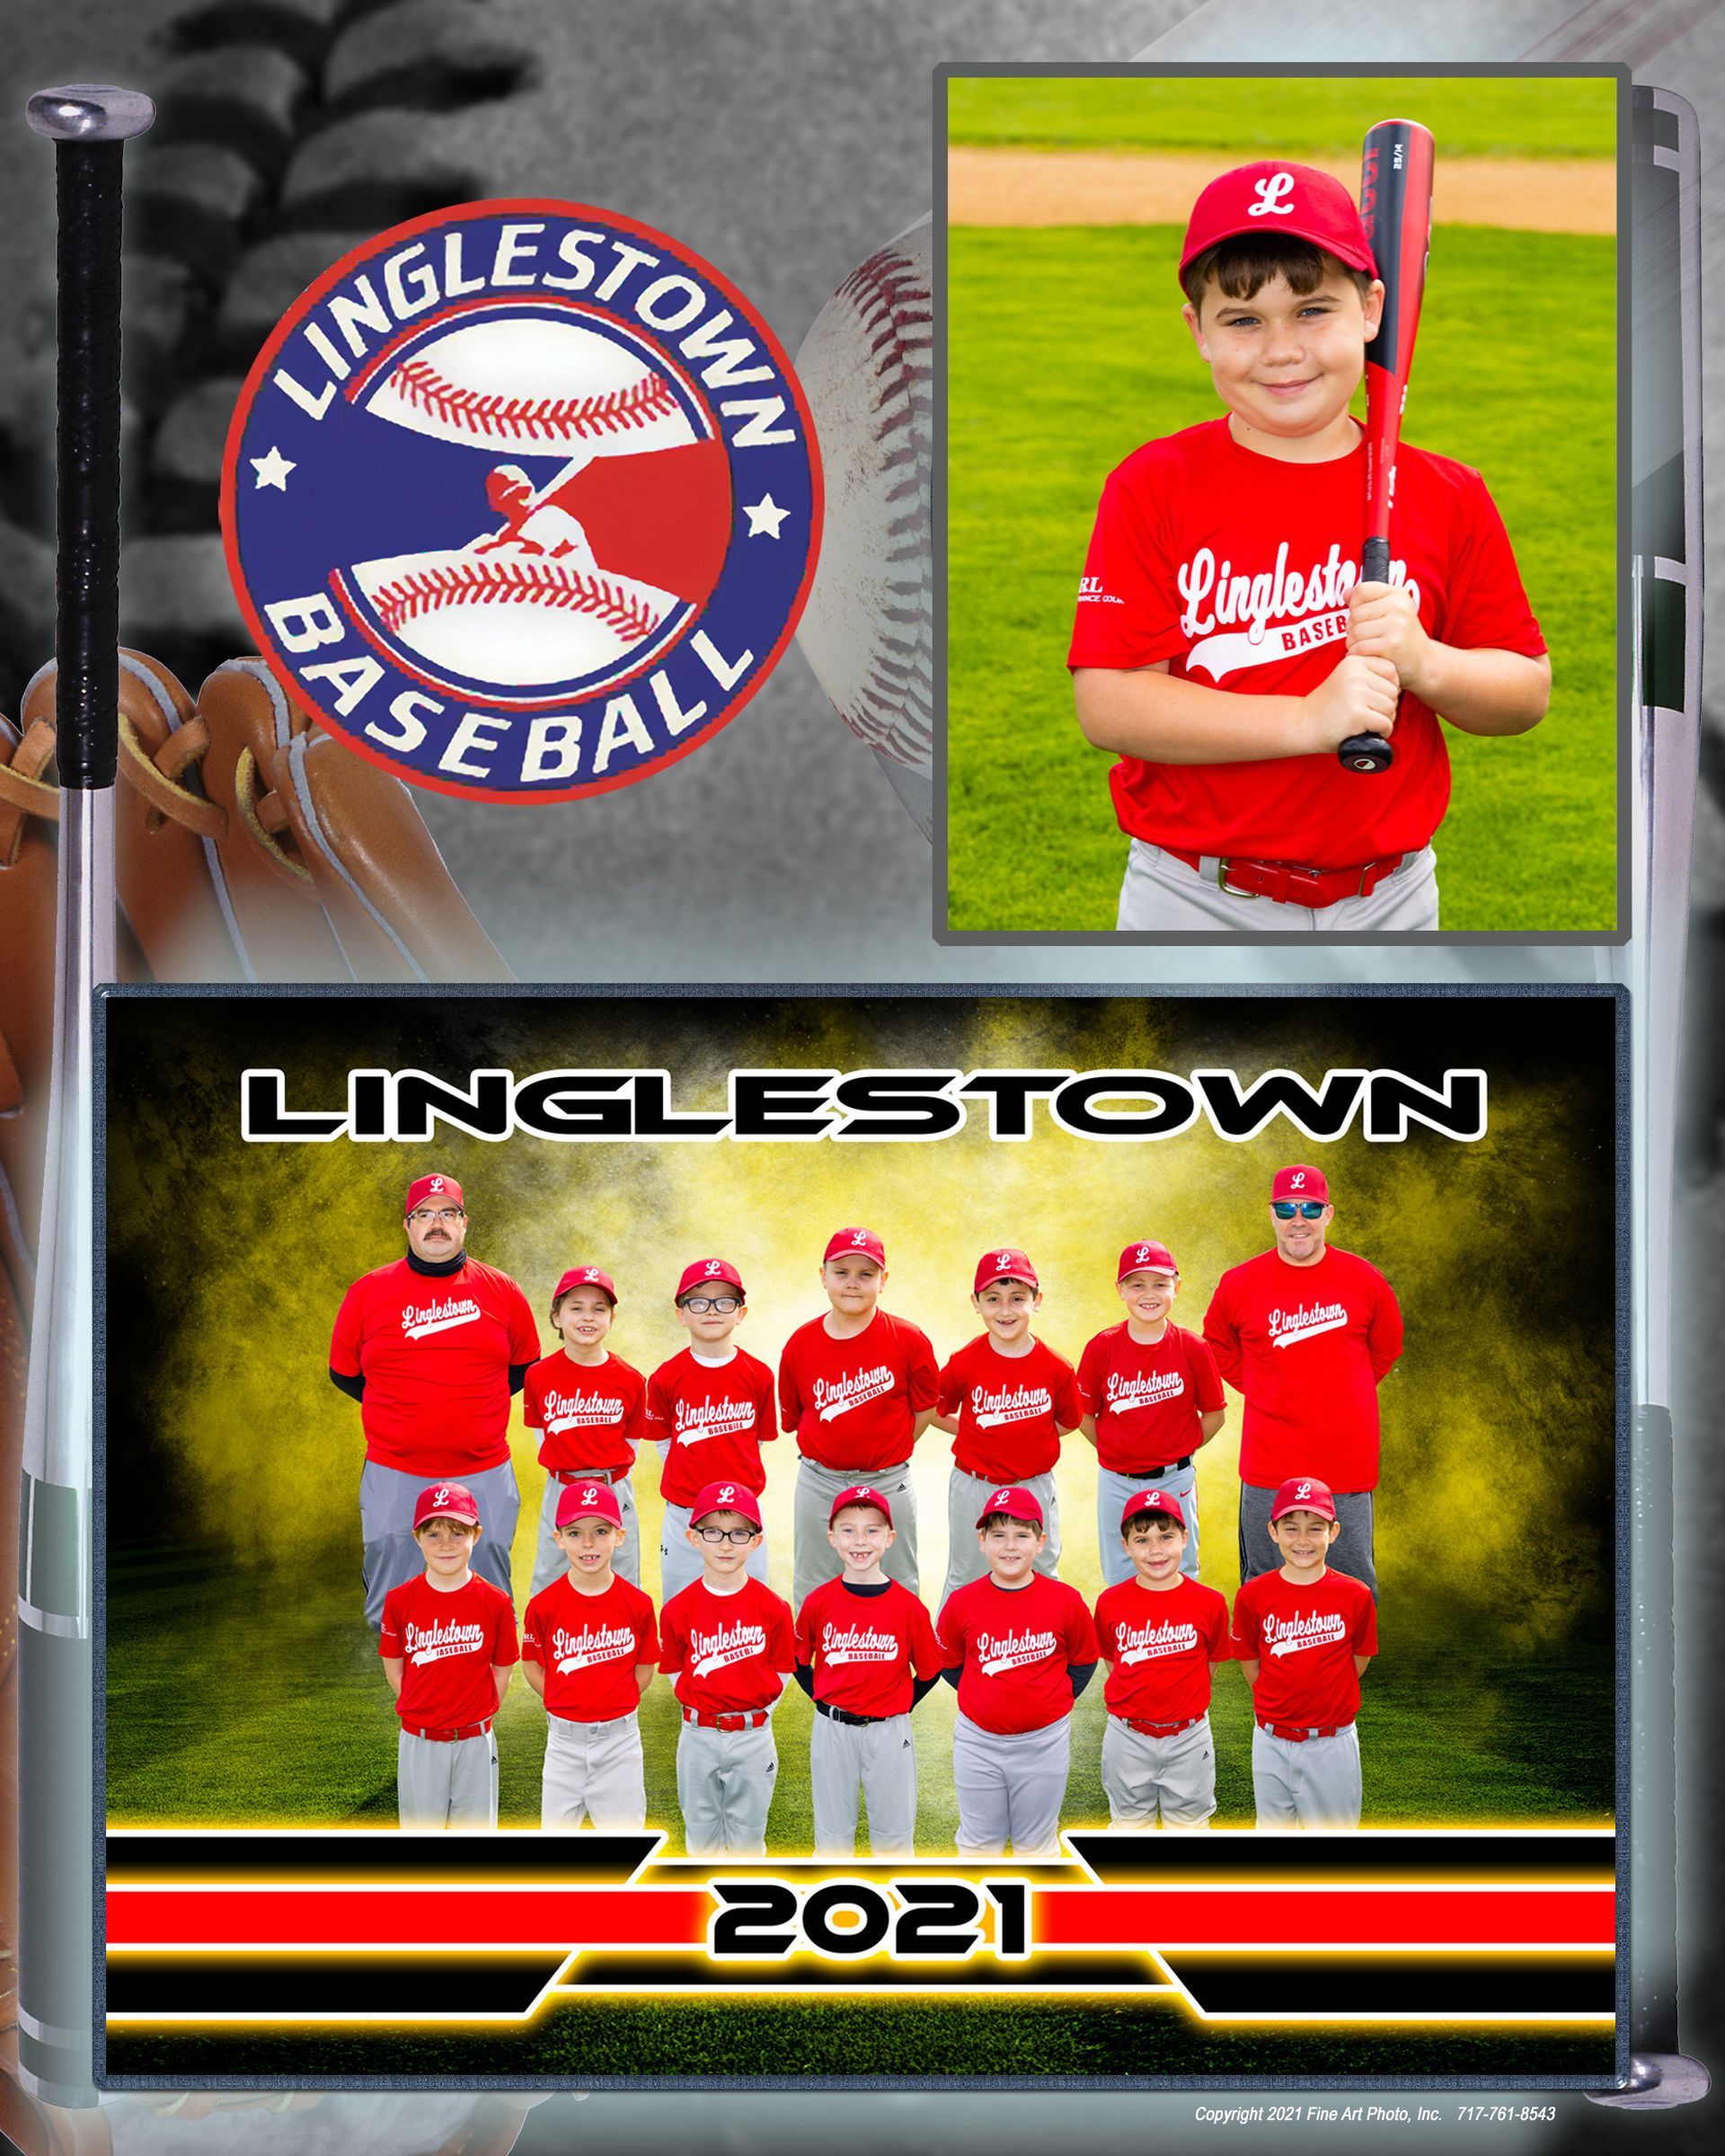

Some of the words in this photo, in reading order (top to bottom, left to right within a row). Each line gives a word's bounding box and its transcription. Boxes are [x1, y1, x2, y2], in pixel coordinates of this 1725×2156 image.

[1248, 172, 1294, 216] L
[1178, 541, 1421, 645] Lingleston
[1281, 614, 1348, 651] BASEB
[429, 1177, 445, 1193] L
[1290, 1171, 1305, 1189] L
[851, 1231, 867, 1246] L
[1136, 1246, 1150, 1264] L
[584, 1268, 599, 1282] L
[704, 1260, 721, 1277] L
[995, 1253, 1012, 1271] L
[402, 1296, 479, 1330] Linglestown
[1268, 1302, 1347, 1337] Linglestown
[813, 1365, 891, 1409] Linglestown
[971, 1384, 1050, 1418] Linglestown
[1107, 1370, 1183, 1402] Linglestown
[544, 1388, 624, 1421] Linglestown
[675, 1395, 755, 1433] Linglestown
[433, 1488, 449, 1507] L
[581, 1488, 597, 1506] L
[717, 1486, 735, 1504] L
[995, 1489, 1010, 1507] L
[1144, 1491, 1161, 1506] L
[1295, 1482, 1312, 1500] L
[405, 1618, 483, 1654] Linglestown
[553, 1623, 633, 1661] Linglestown
[822, 1622, 898, 1657] Linglestown
[1116, 1619, 1196, 1655] Linglestown
[1262, 1610, 1344, 1646] Linglestown
[977, 1628, 1057, 1663] Linglestown
